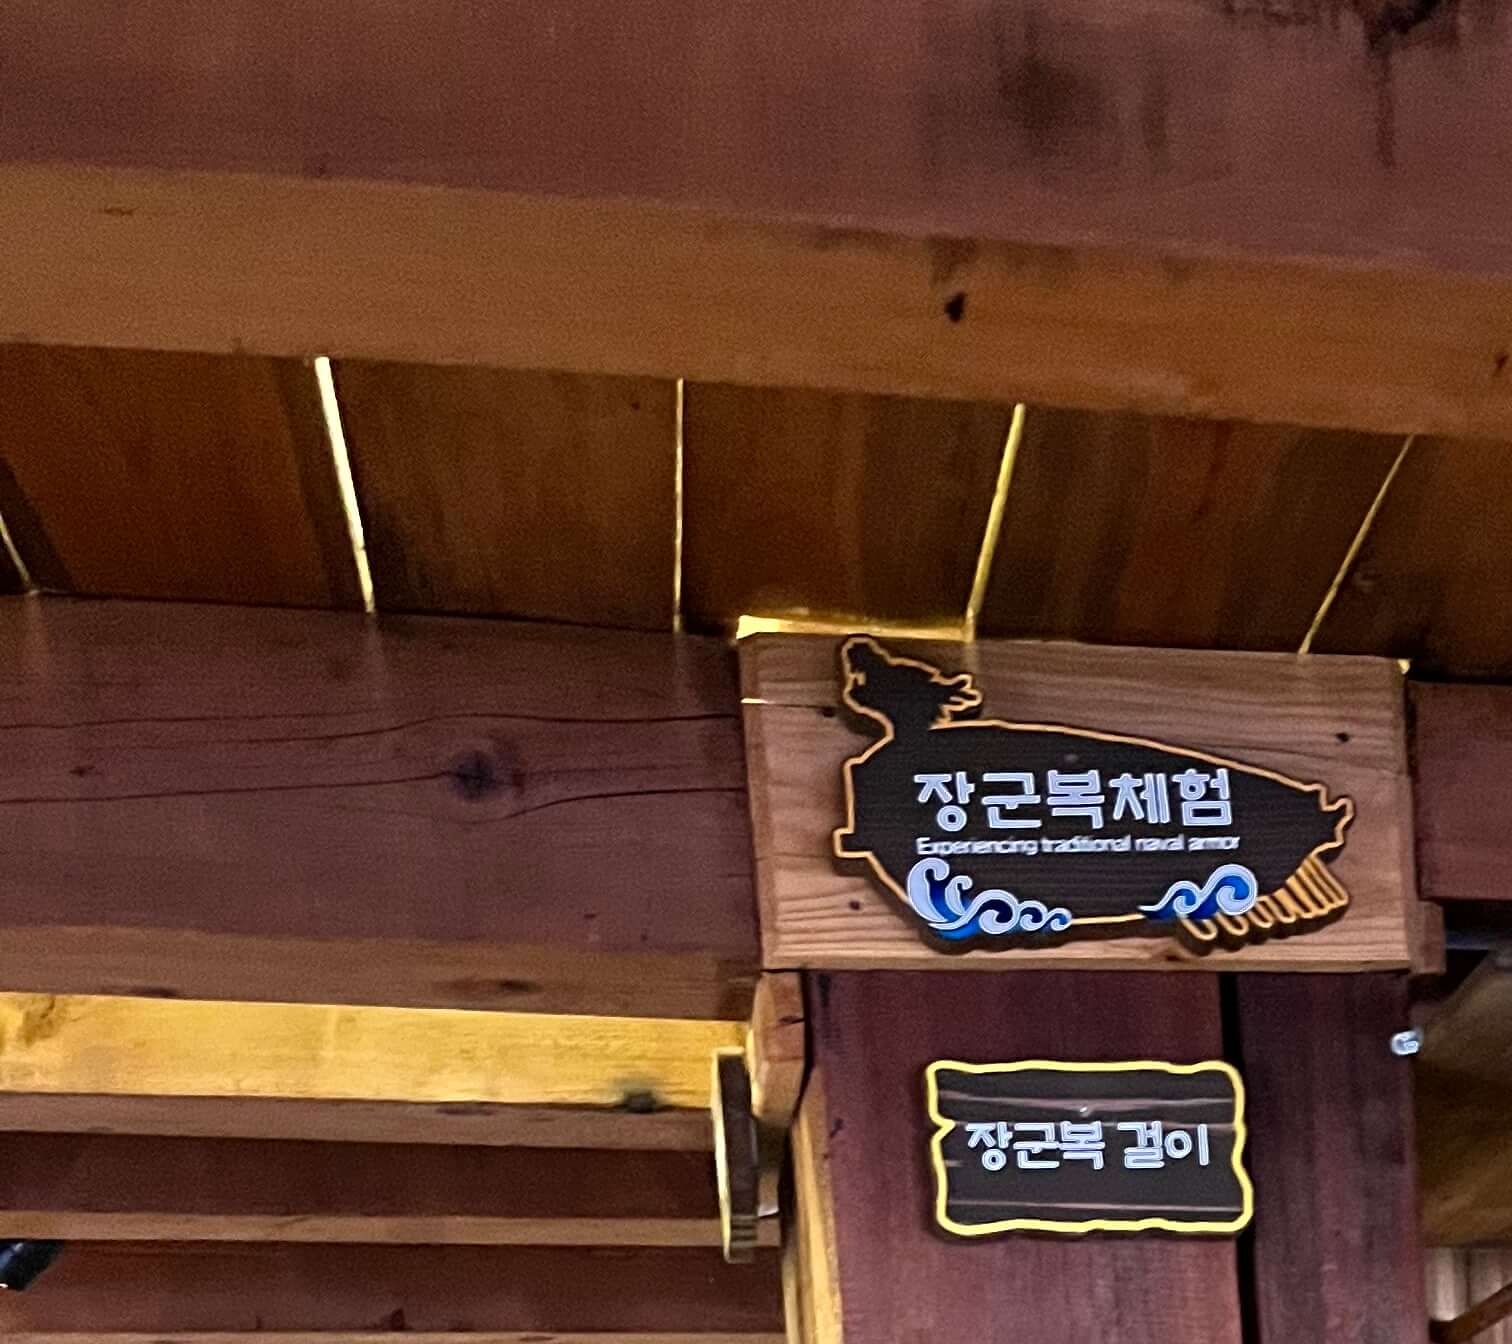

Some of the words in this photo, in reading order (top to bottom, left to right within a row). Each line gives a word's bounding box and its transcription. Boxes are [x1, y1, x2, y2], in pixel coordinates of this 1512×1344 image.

[913, 767, 1233, 832] 장군복체험
[915, 836, 1038, 856] Experiencing
[1040, 834, 1131, 853] traditional
[1134, 833, 1184, 851] naval
[1188, 836, 1241, 851] armor
[965, 1120, 1106, 1171] 장군복
[1117, 1120, 1209, 1169] 걸이
